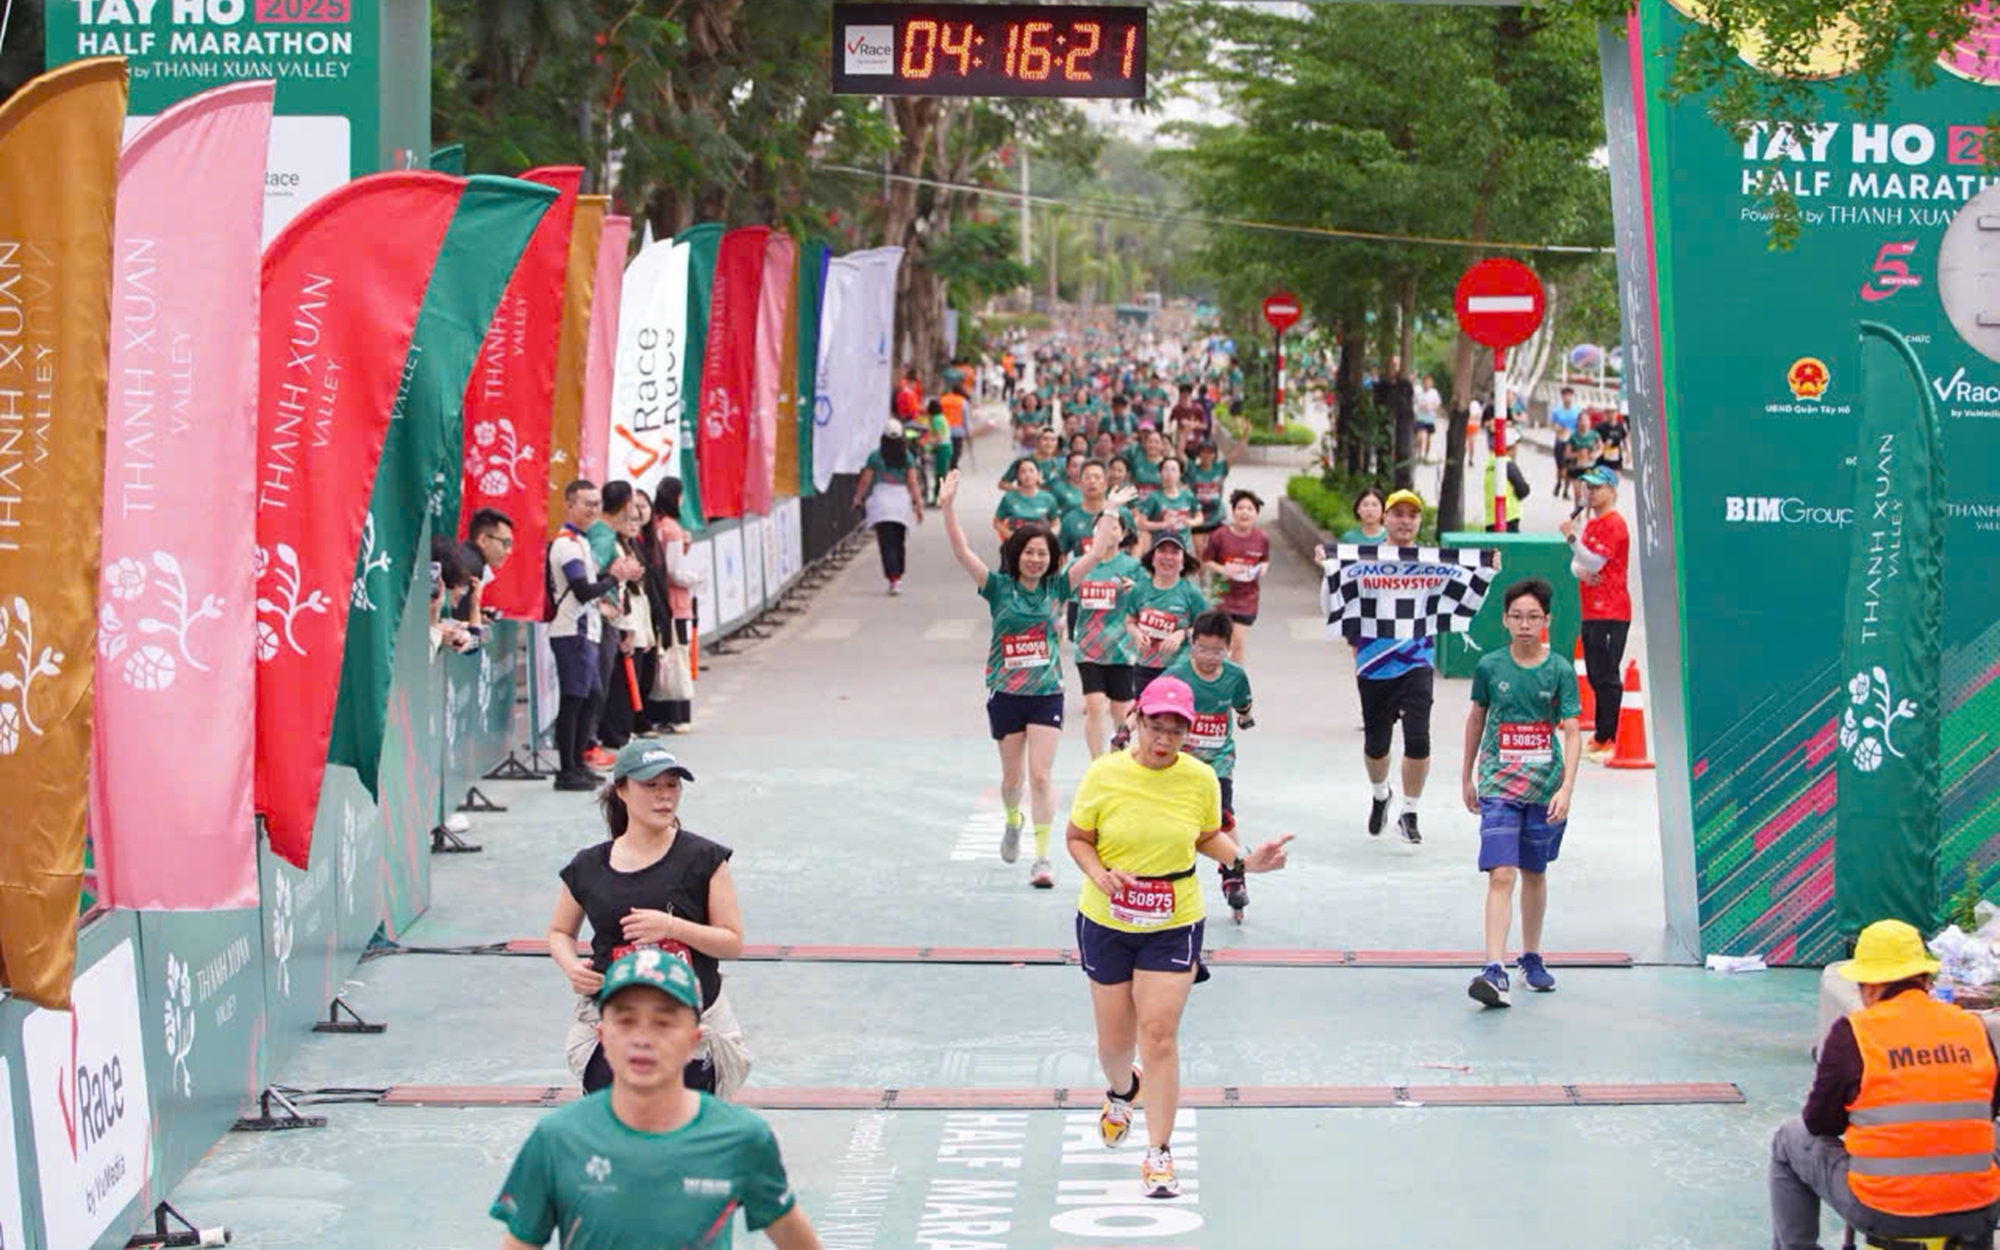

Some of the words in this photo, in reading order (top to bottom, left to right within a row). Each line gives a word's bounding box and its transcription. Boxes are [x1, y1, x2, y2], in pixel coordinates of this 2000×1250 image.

[172, 0, 245, 25] HO
[78, 32, 155, 55] HALF
[170, 32, 352, 55] MARATHON
[901, 20, 1138, 80] 04:16:21
[134, 64, 151, 79] by
[153, 62, 217, 77] THANH
[223, 62, 273, 77] XUAN
[277, 62, 350, 77] VALLEY
[1738, 121, 1840, 162] TAY
[1851, 122, 1936, 166] HO
[1741, 169, 1831, 197] HALF
[1806, 206, 1824, 224] by
[1828, 206, 1902, 225] THANH
[123, 238, 158, 353] XUAN
[35, 342, 54, 463] VALLEY
[259, 382, 309, 510] THANH
[287, 272, 334, 375] XUAN
[312, 357, 343, 447] VALLEY
[122, 368, 156, 520] THANH
[1861, 531, 1885, 644] THANH
[1873, 434, 1894, 520] XUAN
[1888, 498, 1903, 579] VALLEY
[1502, 733, 1511, 745] B
[1127, 890, 1173, 909] 50875
[1888, 1043, 1973, 1070] Media
[937, 1113, 1029, 1168] HALF
